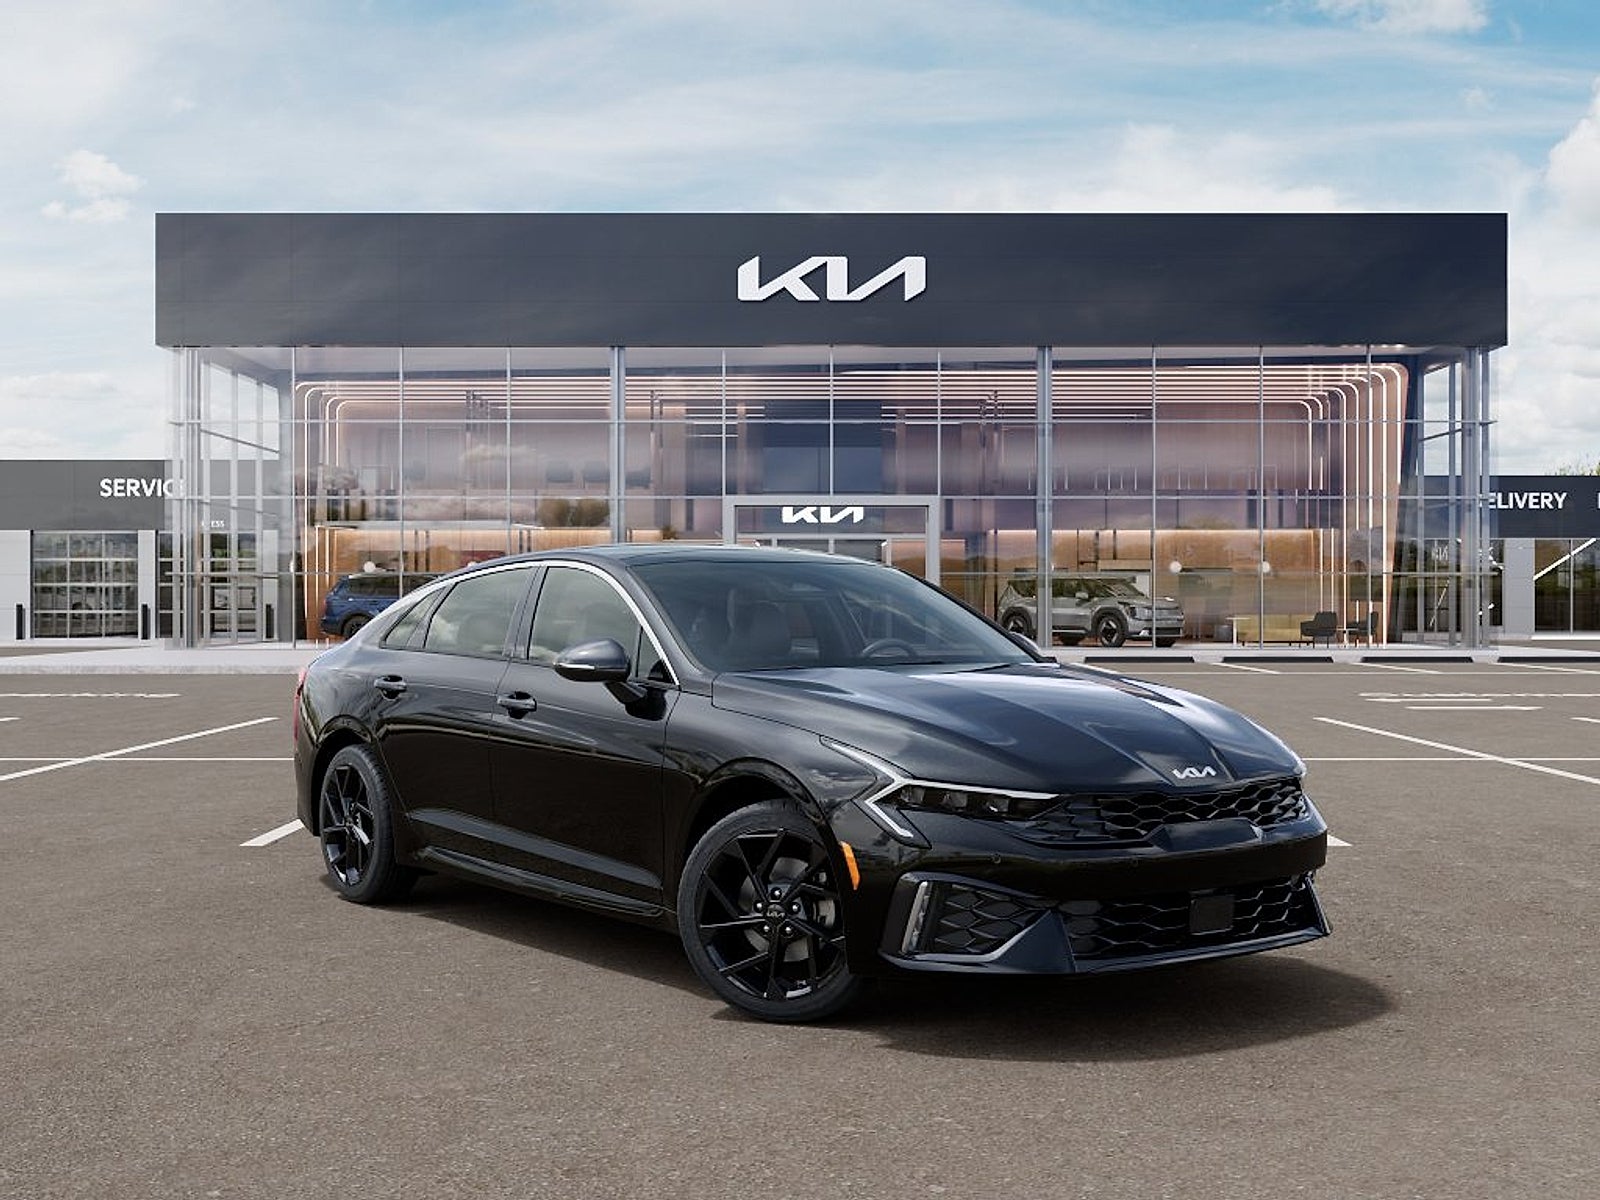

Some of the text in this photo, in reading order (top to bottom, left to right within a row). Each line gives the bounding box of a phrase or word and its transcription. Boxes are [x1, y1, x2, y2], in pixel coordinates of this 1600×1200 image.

[737, 256, 926, 302] KIA
[99, 478, 185, 497] SERVIC
[1479, 492, 1567, 509] ELIVERY
[782, 506, 864, 524] KIA
[1172, 766, 1217, 779] KIA
